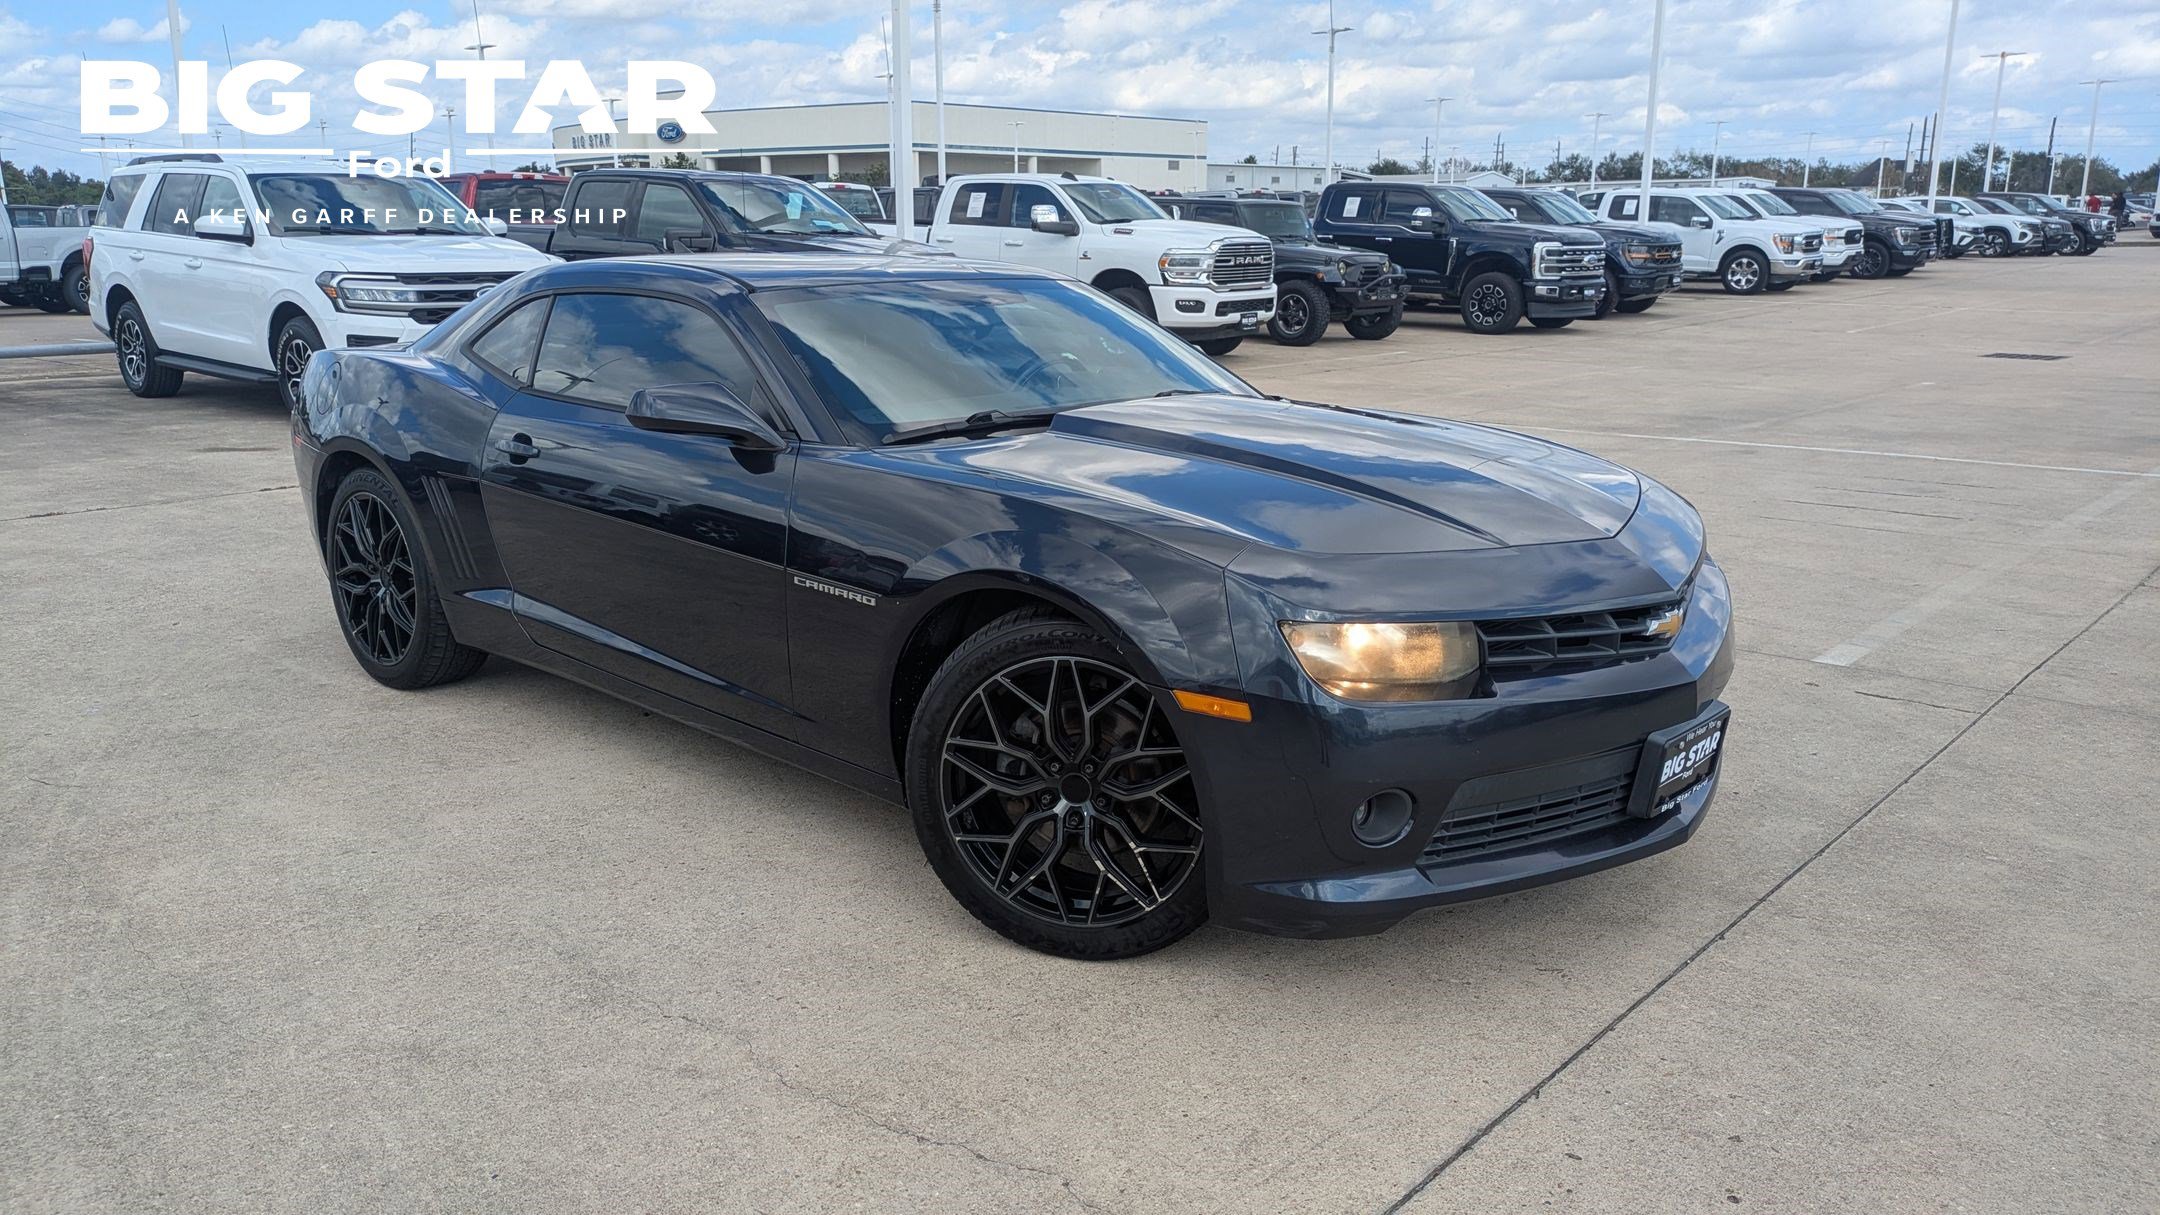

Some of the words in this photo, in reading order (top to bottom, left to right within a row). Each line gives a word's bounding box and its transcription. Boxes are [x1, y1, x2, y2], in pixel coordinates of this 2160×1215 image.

[571, 135, 587, 149] BIG
[588, 133, 611, 149] STAR
[1236, 256, 1264, 265] RAM
[793, 576, 877, 607] CAMARO
[1660, 751, 1687, 783] BIG
[1686, 731, 1721, 767] STAR
[1661, 801, 1675, 813] Big
[1676, 790, 1691, 804] Star
[1692, 777, 1709, 793] Ford
